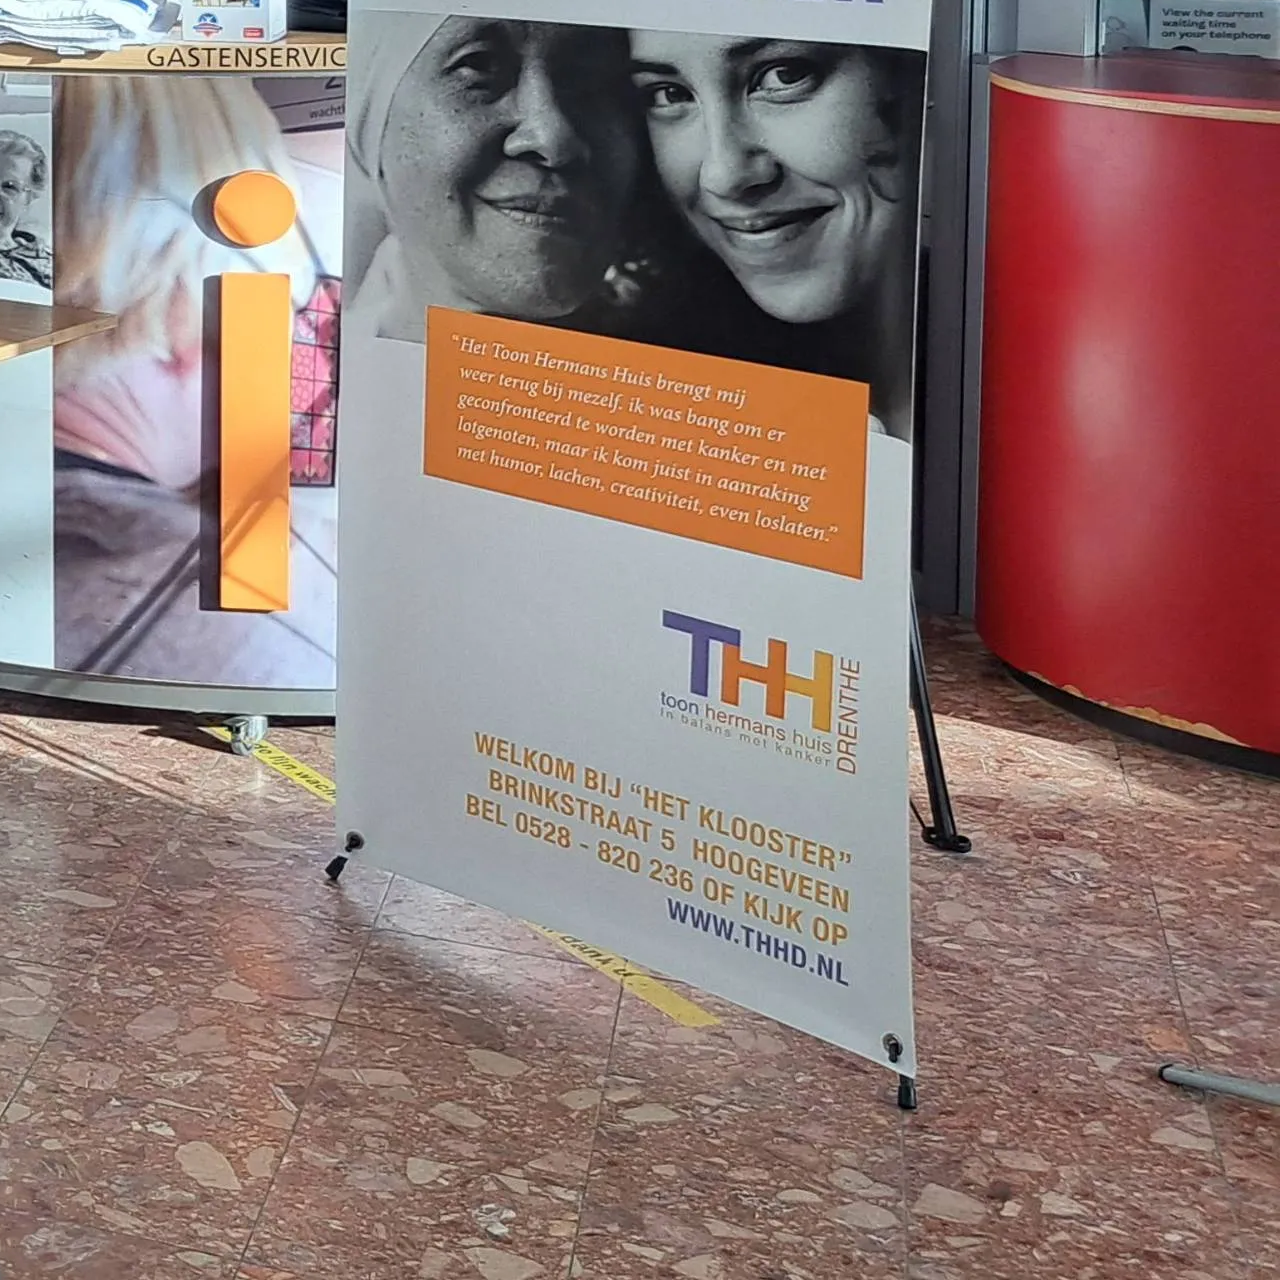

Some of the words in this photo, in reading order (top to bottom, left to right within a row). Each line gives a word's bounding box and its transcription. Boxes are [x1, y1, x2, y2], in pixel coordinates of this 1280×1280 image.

[1162, 8, 1190, 17] View
[1194, 8, 1214, 17] the
[1216, 10, 1264, 18] current
[1162, 19, 1206, 29] waiting
[1209, 19, 1236, 28] time
[1209, 31, 1271, 40] telephone
[147, 47, 346, 68] GASTENSERVIC
[459, 367, 495, 384] weer
[498, 373, 539, 397] terug
[543, 380, 564, 402] bij
[567, 387, 623, 413] mezelf.
[628, 396, 646, 416] ik
[650, 405, 681, 423] was
[686, 409, 729, 436] bang
[733, 422, 763, 437] om
[767, 428, 786, 444] er
[492, 343, 530, 366] Toon
[534, 351, 608, 379] Hermans
[612, 366, 651, 388] Huis
[656, 374, 711, 403] brengt
[716, 387, 747, 410] mij
[457, 392, 572, 428] geconfronteerd
[575, 416, 591, 432] te
[595, 419, 656, 446] worden
[660, 433, 694, 454] met
[698, 438, 760, 469] kanker
[763, 455, 786, 472] en
[790, 462, 828, 482] met
[457, 416, 540, 450] lotgenoten,
[545, 438, 589, 458] maar
[593, 444, 609, 463] ik
[612, 450, 649, 472] kom
[650, 457, 691, 481] juist
[695, 468, 713, 487] in
[716, 474, 812, 512] aanraking
[457, 444, 486, 462] met
[490, 450, 544, 477] humor,
[548, 464, 605, 492] lachen,
[610, 480, 704, 515] creativiteit,
[709, 504, 750, 524] even
[662, 609, 834, 733] THH
[661, 691, 699, 715] toon
[705, 703, 786, 741] hermans
[792, 729, 832, 755] huis
[681, 713, 732, 738] balans
[739, 732, 769, 748] met
[775, 740, 832, 767] kanker
[836, 656, 861, 775] DRENTHE
[474, 731, 576, 783] WELKOM
[584, 767, 623, 800] BIJ
[465, 793, 508, 827] BEL
[515, 811, 572, 849] 0528
[597, 840, 641, 874] 820
[649, 859, 693, 894] 236
[703, 878, 735, 907] OF
[743, 891, 804, 934] KIJK
[812, 916, 848, 947] OP
[488, 769, 652, 842] BRINKSTRAAT
[660, 828, 676, 851] 5
[692, 838, 850, 912] HOOGEVEEN
[666, 897, 850, 987] WWW.THHD.NL
